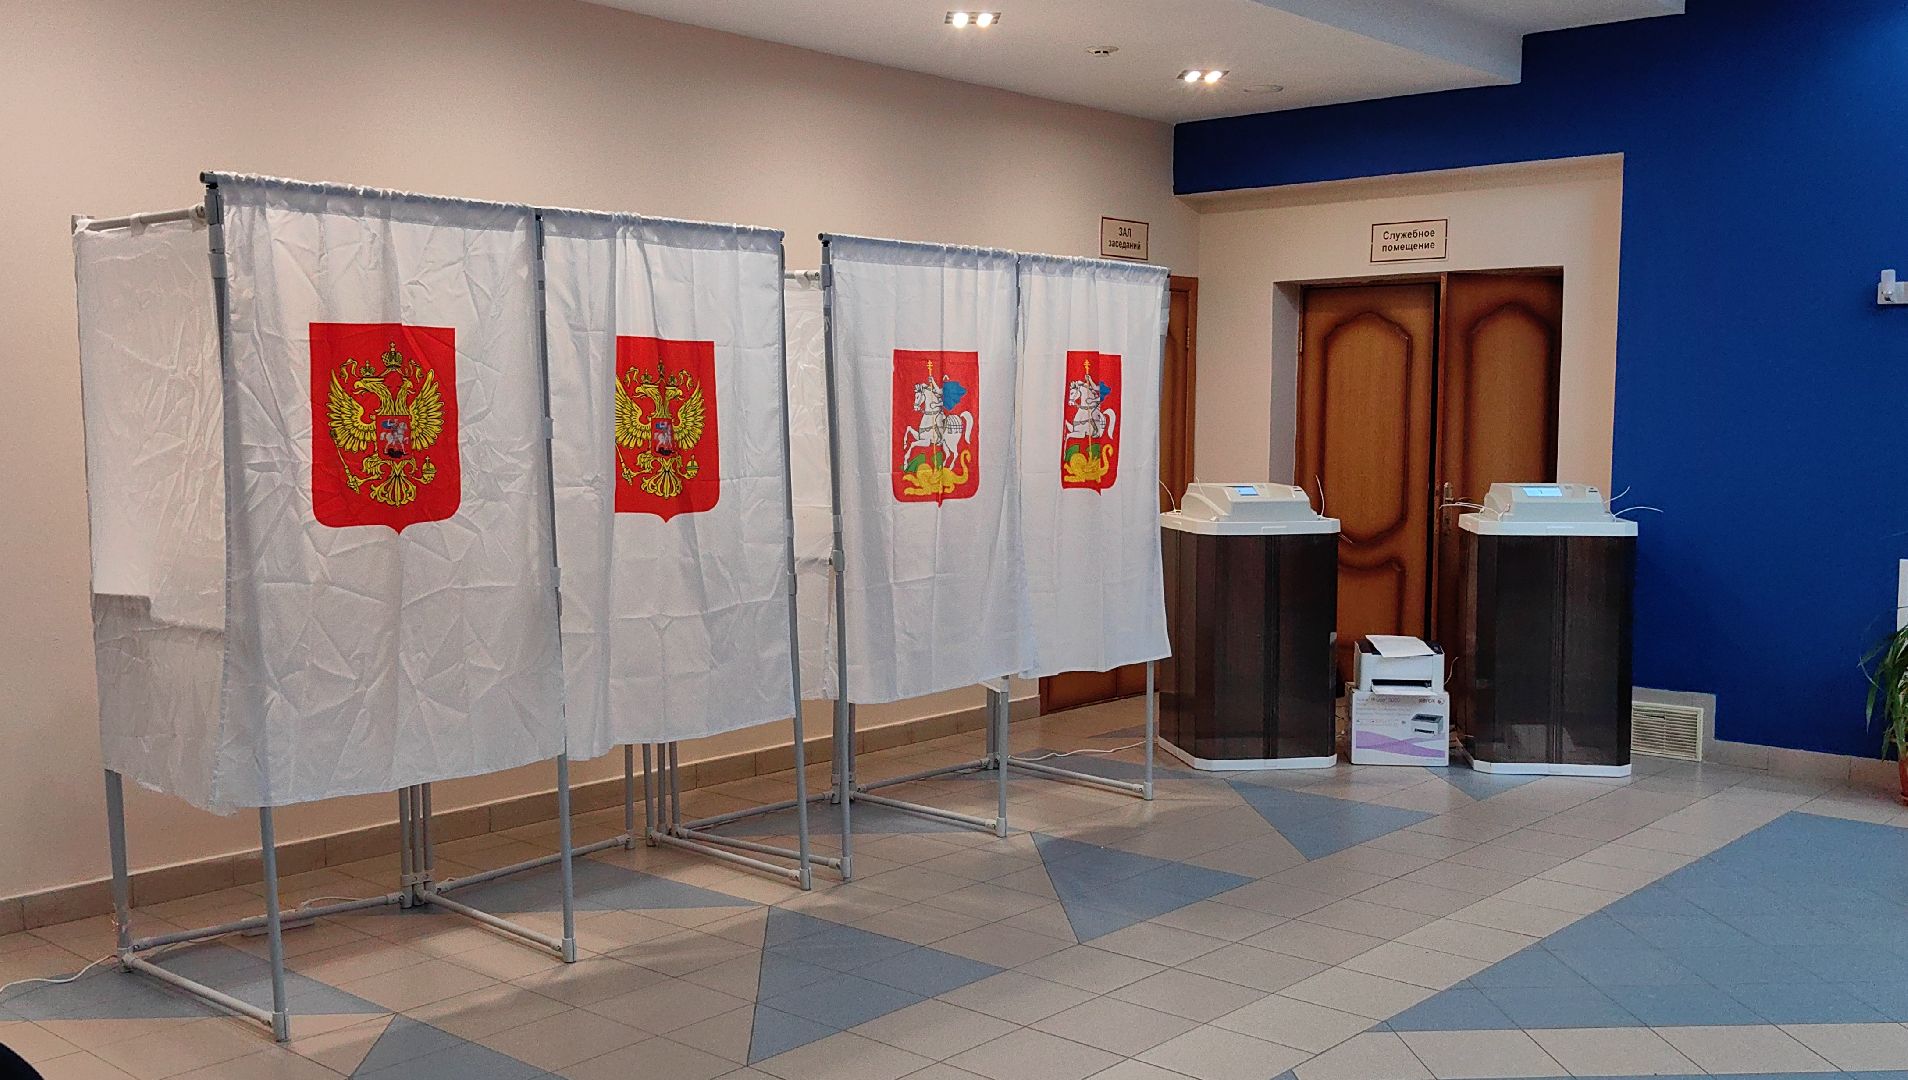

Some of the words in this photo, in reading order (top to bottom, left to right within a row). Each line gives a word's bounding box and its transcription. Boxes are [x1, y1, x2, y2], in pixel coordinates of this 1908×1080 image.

[1118, 226, 1132, 238] ЗАЛ
[1383, 229, 1435, 241] Служебное
[1108, 239, 1141, 250] заседаний
[1382, 242, 1435, 252] помещение
